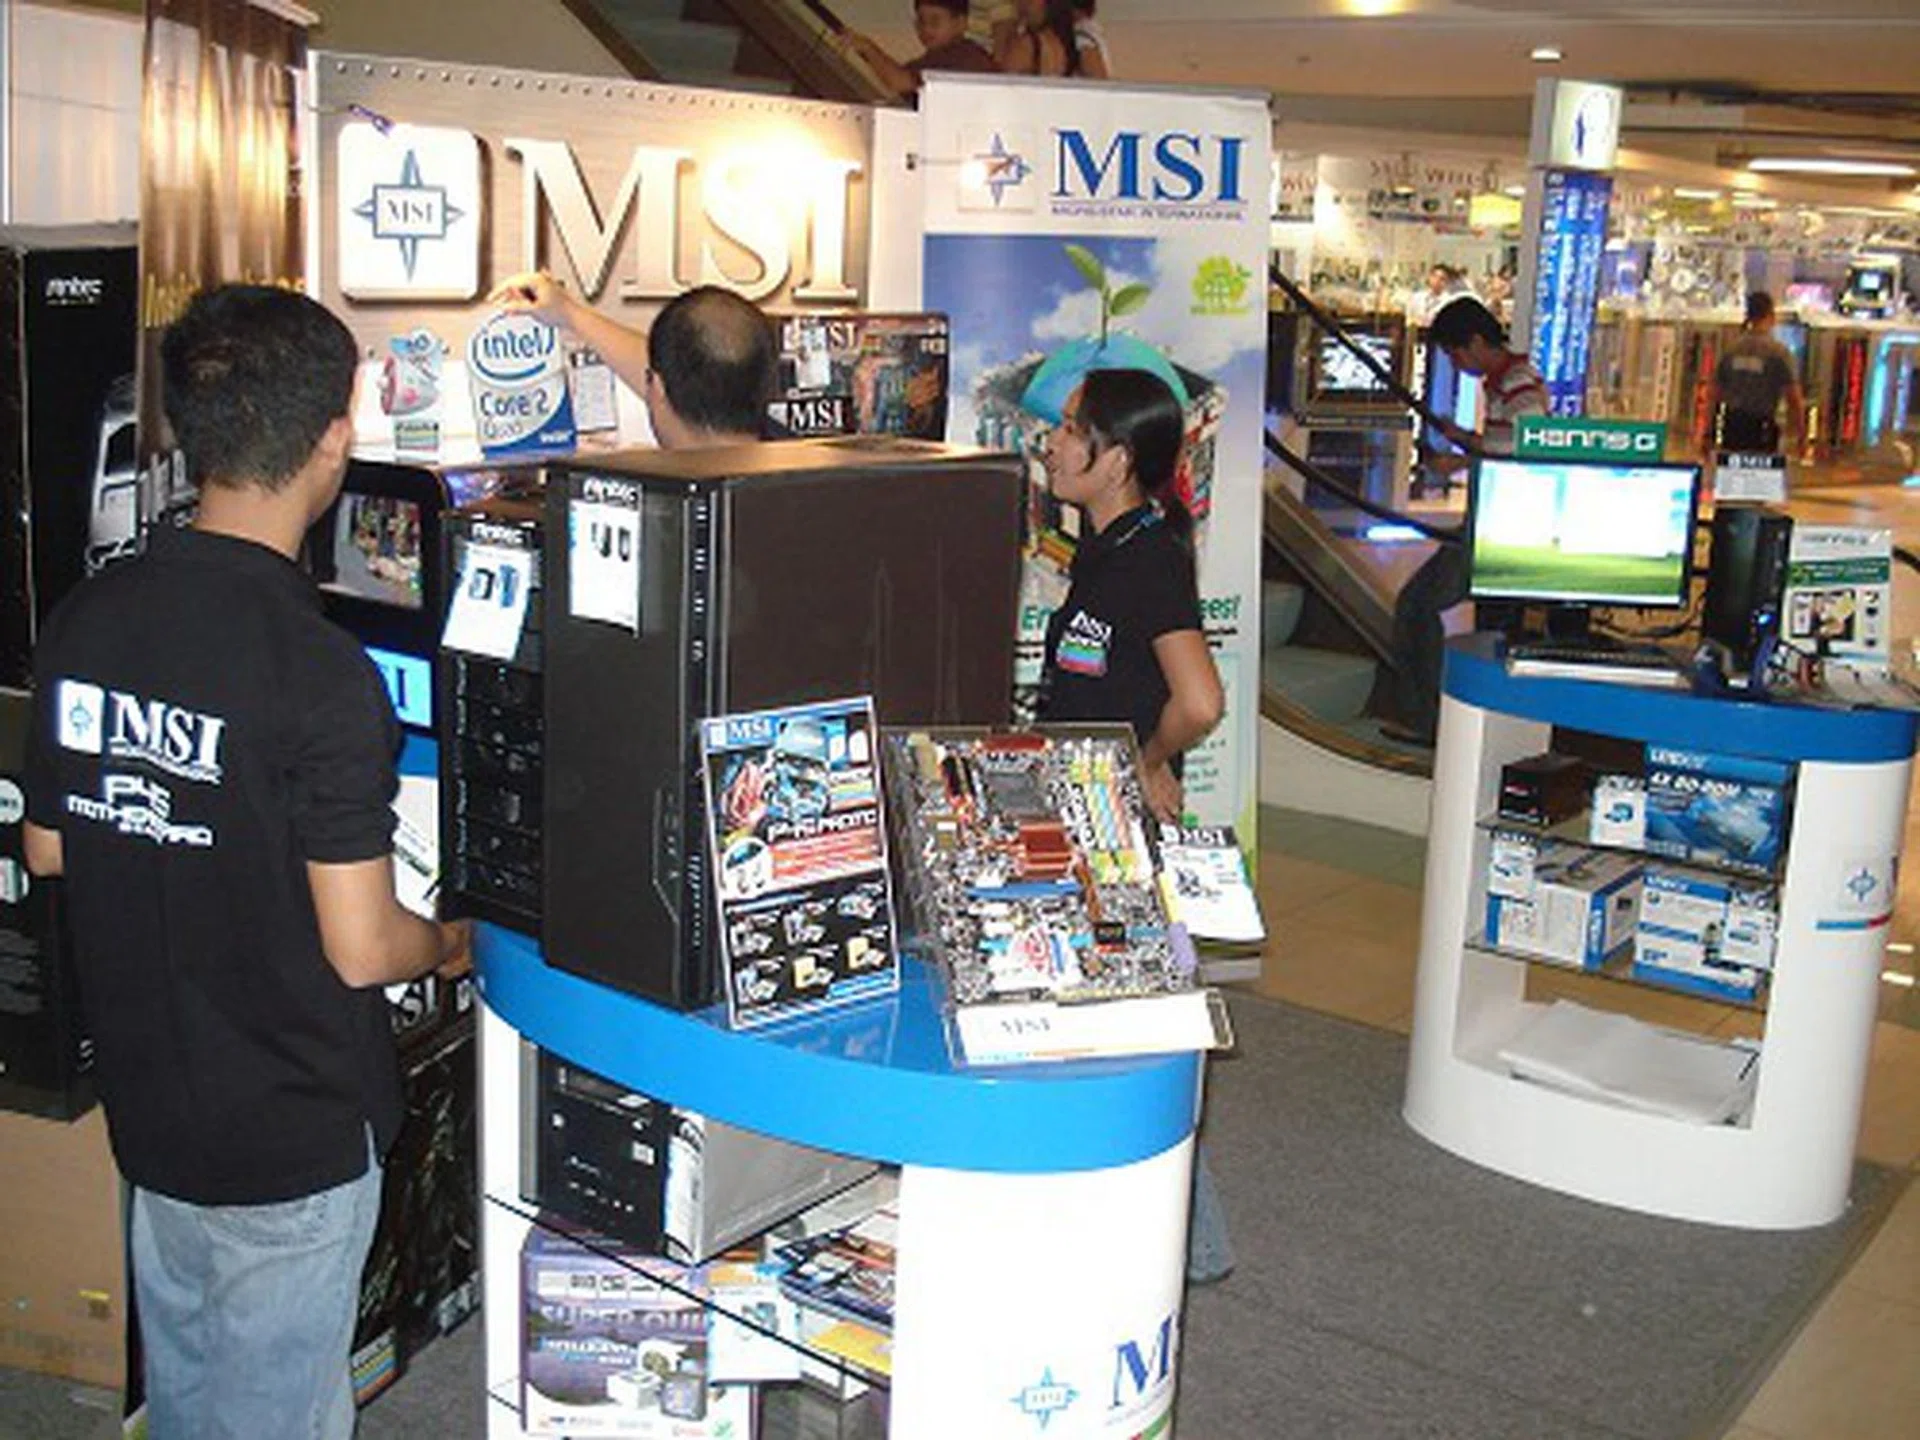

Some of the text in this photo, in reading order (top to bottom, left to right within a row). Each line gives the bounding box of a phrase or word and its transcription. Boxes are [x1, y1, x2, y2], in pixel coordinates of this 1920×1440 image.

[1051, 128, 1243, 201] MSI
[387, 193, 435, 223] MSI
[504, 138, 862, 300] MSI
[484, 325, 543, 358] intel
[480, 387, 549, 417] Core 2
[791, 400, 845, 431] MSI
[1021, 604, 1051, 630] En
[109, 690, 226, 770] MSI
[729, 718, 773, 739] MSI
